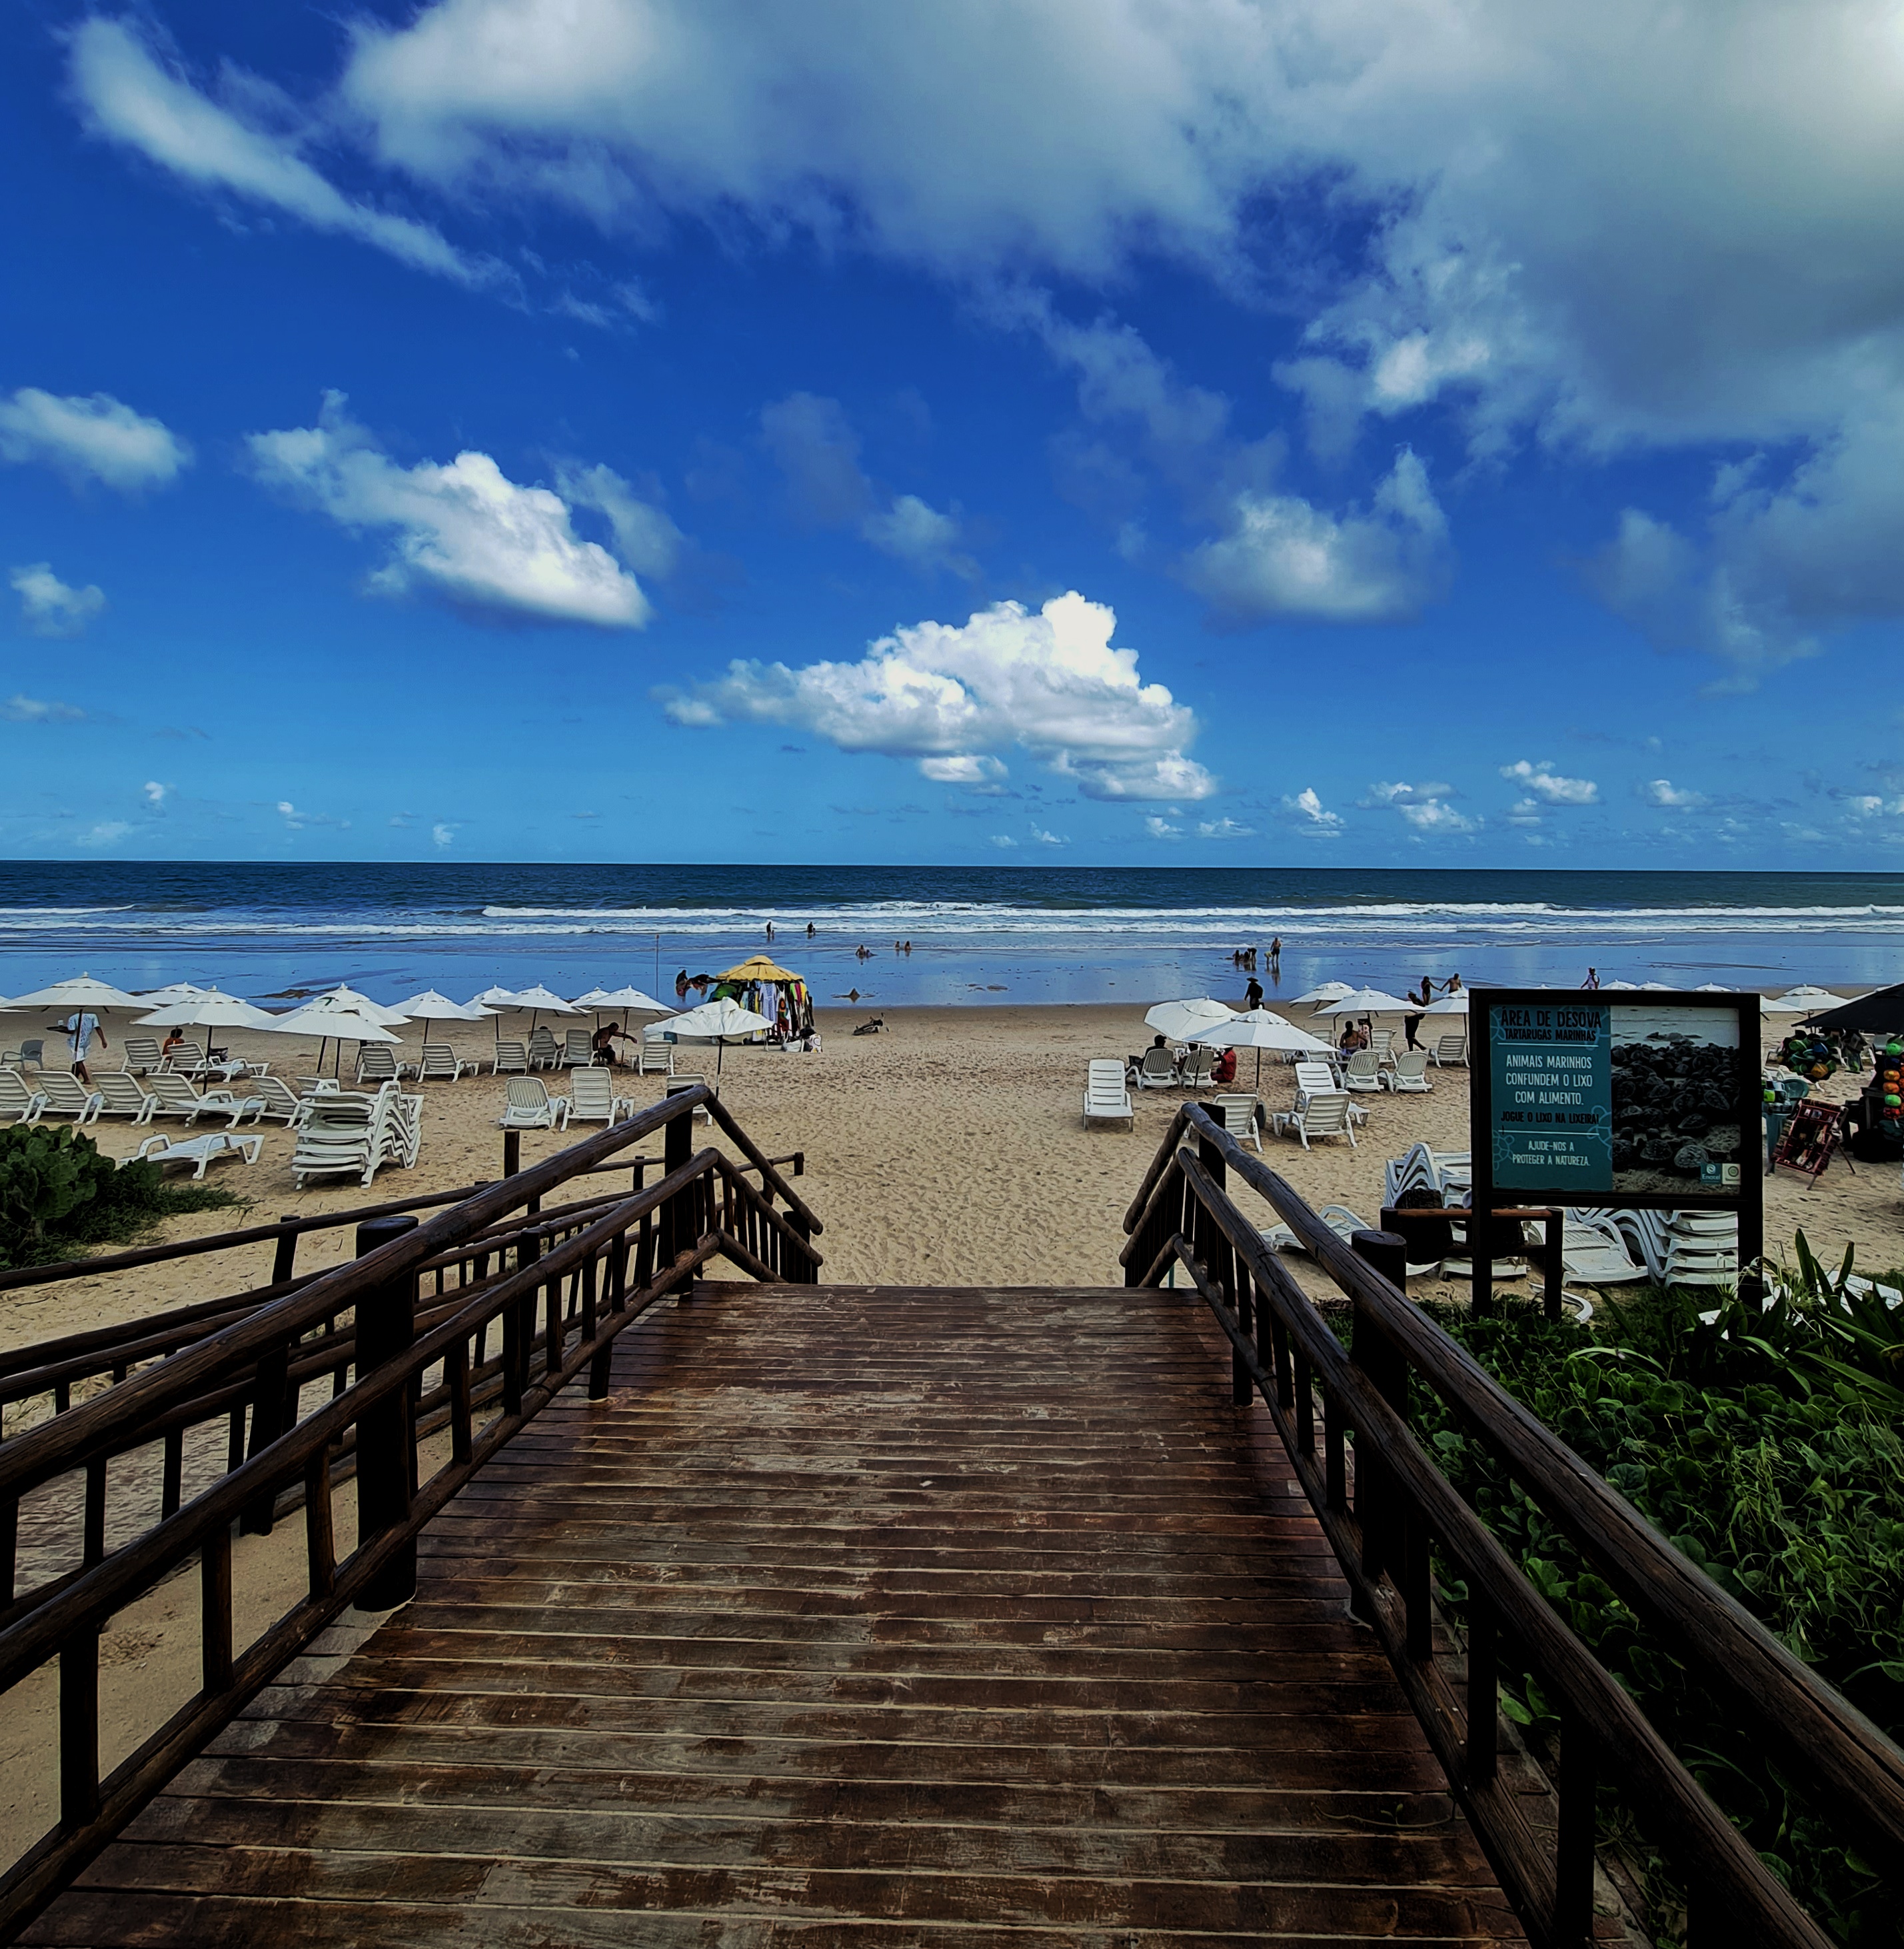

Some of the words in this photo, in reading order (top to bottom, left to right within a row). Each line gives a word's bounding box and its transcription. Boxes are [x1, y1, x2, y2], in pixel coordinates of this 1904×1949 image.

[1501, 1006, 1531, 1026] ÁREA
[1537, 1010, 1551, 1027] DE
[1557, 1011, 1601, 1028] DESOVA
[1505, 1028, 1551, 1040] TARTARUGAS
[1555, 1030, 1595, 1041] MARINHAS
[1506, 1054, 1543, 1068] ANIMAIS
[1547, 1055, 1592, 1069] MARINHOS
[1505, 1072, 1559, 1086] CONFUNDEM
[1563, 1074, 1569, 1086] O
[1573, 1074, 1592, 1087] LIXO
[1515, 1091, 1534, 1103] COM
[1539, 1091, 1584, 1105] ALIMENTO.
[1501, 1111, 1524, 1122] JOGUE
[1527, 1112, 1533, 1122] O
[1535, 1112, 1552, 1122] LIXO
[1555, 1113, 1565, 1123] NA
[1569, 1113, 1599, 1124] LIXEIRA!
[1528, 1140, 1566, 1151] AJUDE-NOS
[1569, 1142, 1574, 1152] A
[1512, 1154, 1545, 1164] PROTEGER
[1547, 1155, 1553, 1165] A
[1555, 1155, 1591, 1166] NATUREZA.
